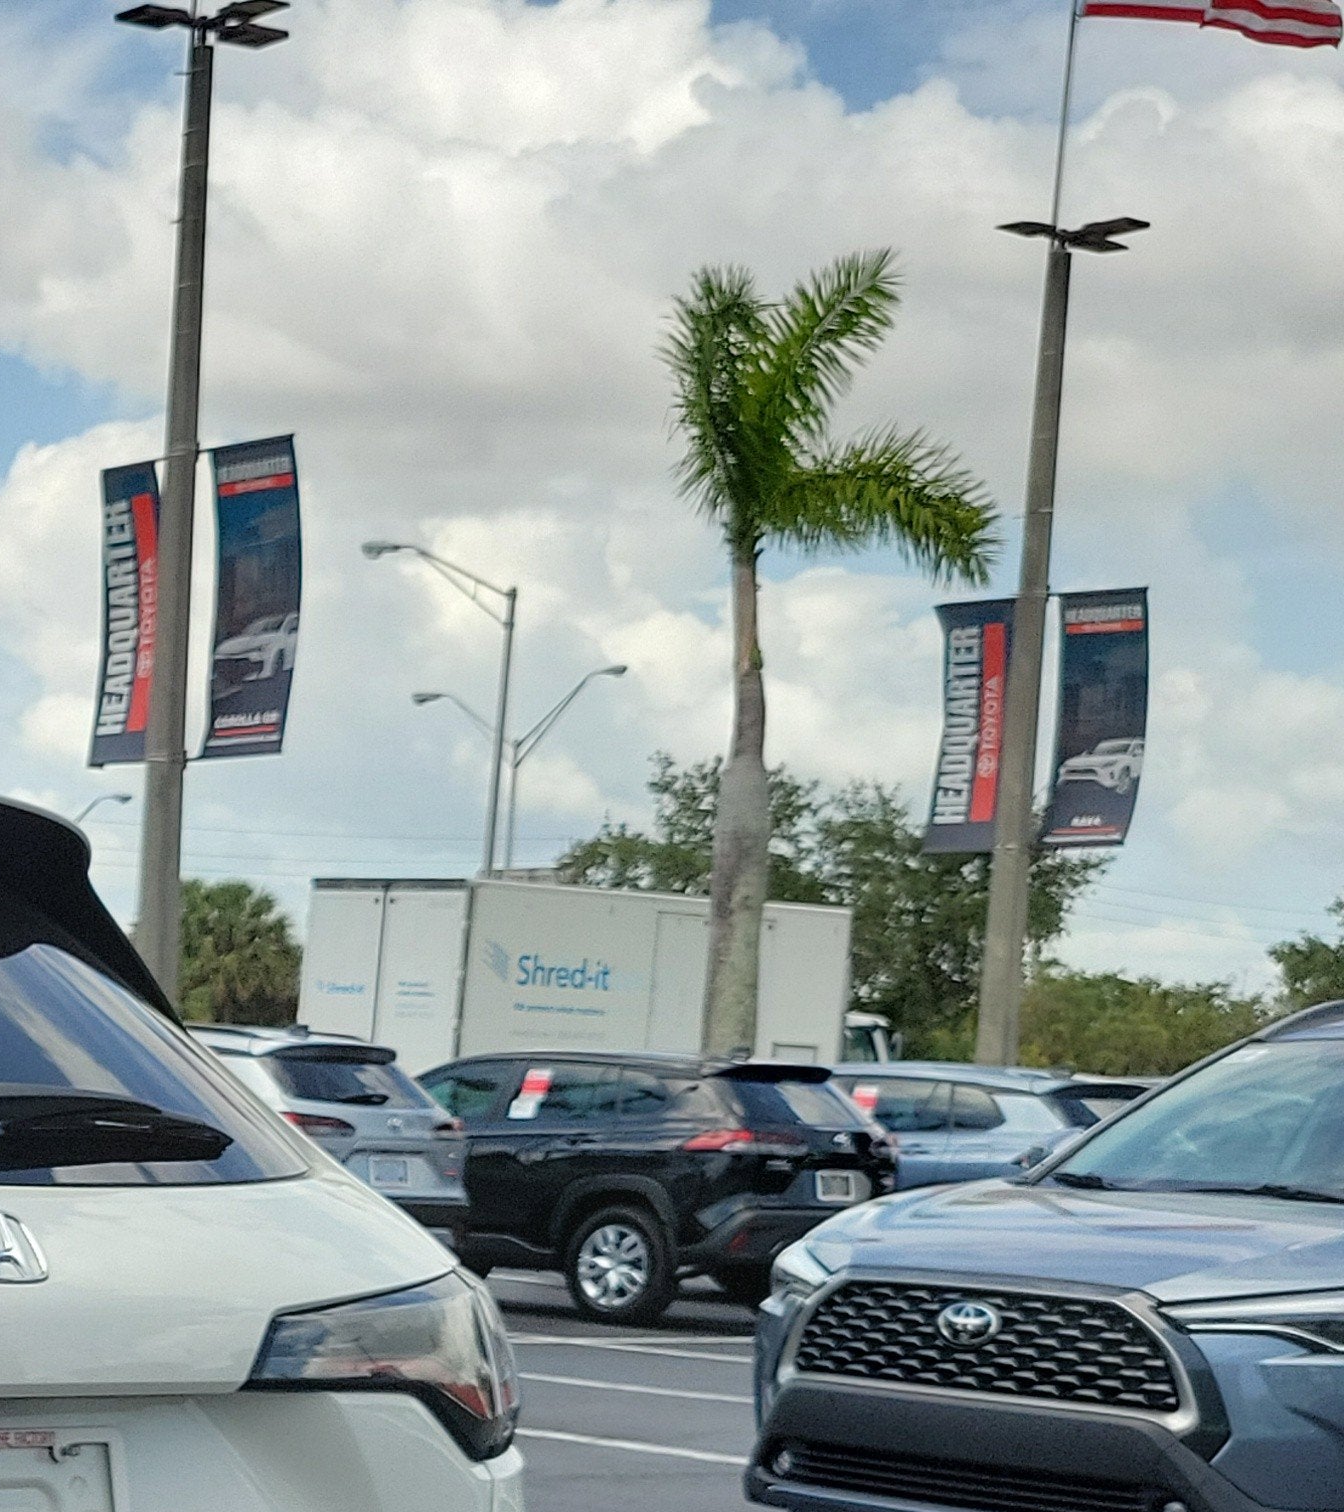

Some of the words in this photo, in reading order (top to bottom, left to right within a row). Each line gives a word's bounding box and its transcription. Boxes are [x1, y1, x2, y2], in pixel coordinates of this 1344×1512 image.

[96, 499, 139, 736] HEADQUARTER
[138, 556, 157, 650] TOYOTA
[932, 625, 981, 825] HEADQUARTER
[981, 675, 1003, 752] TOYOTA
[516, 953, 610, 991] Shred-it
